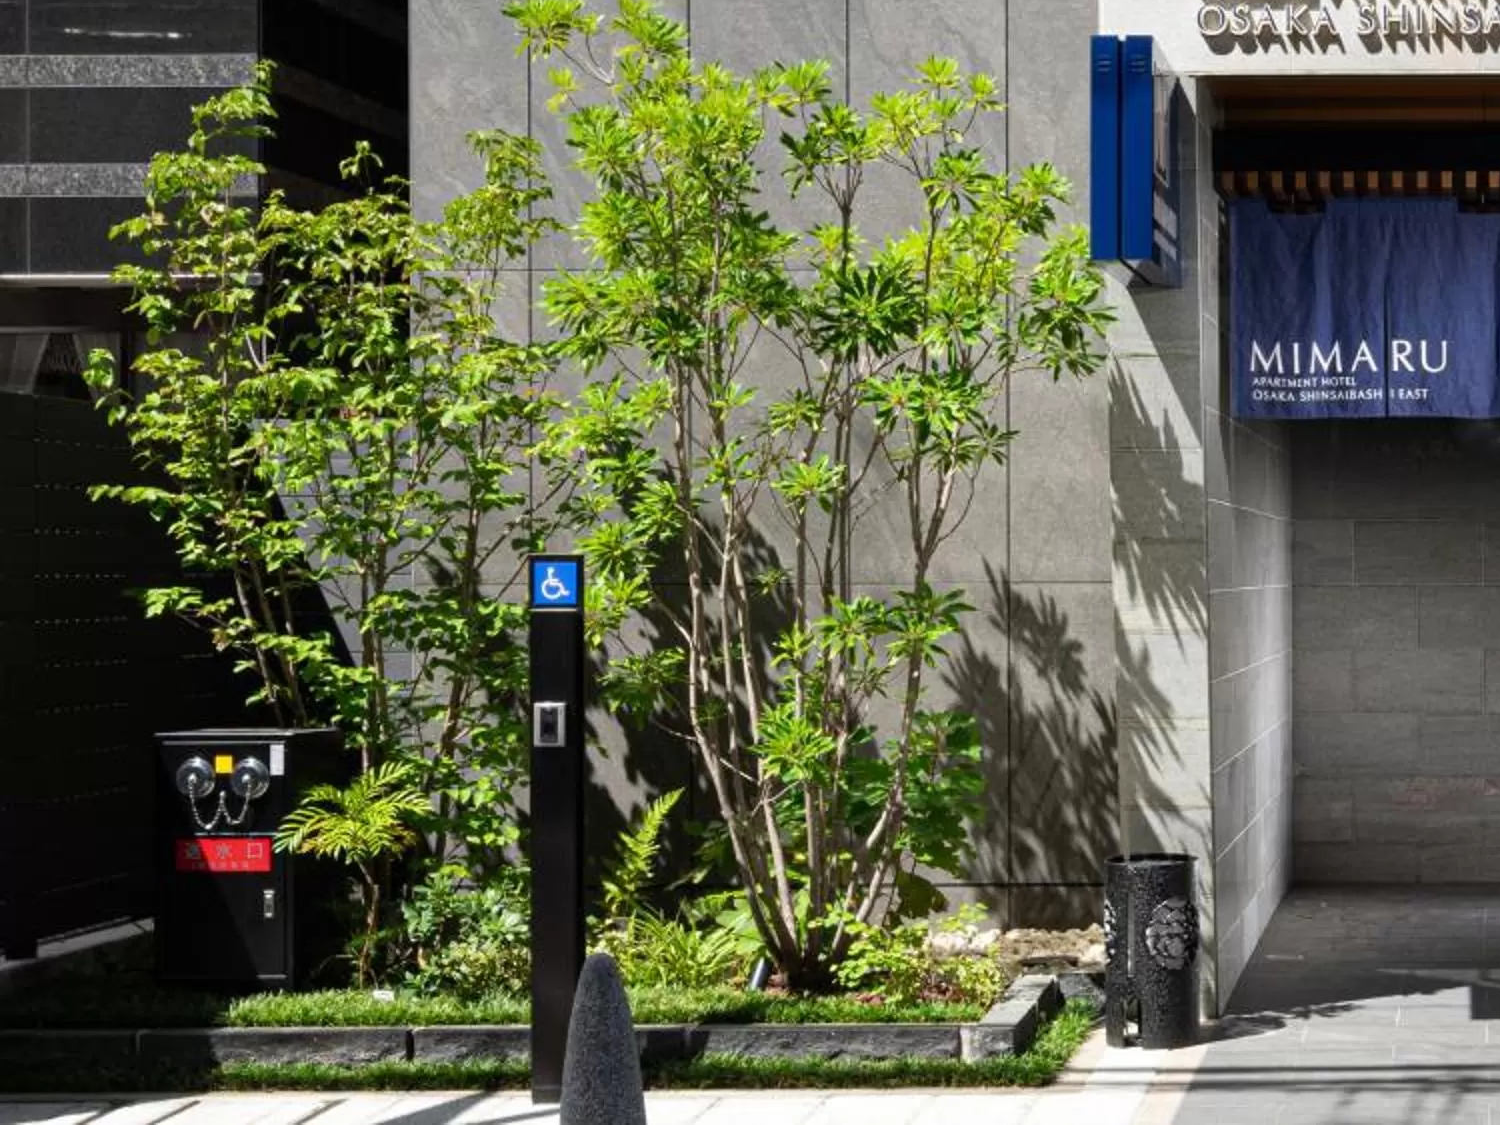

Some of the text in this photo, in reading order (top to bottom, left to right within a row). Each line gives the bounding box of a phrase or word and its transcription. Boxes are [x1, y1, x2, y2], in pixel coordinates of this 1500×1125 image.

[1197, 3, 1340, 35] OSAKA
[1250, 339, 1448, 374] MIMARU
[1253, 377, 1357, 388] APARTMENT HOTEL
[1253, 390, 1296, 402] OSAKA
[1399, 388, 1430, 400] EAST
